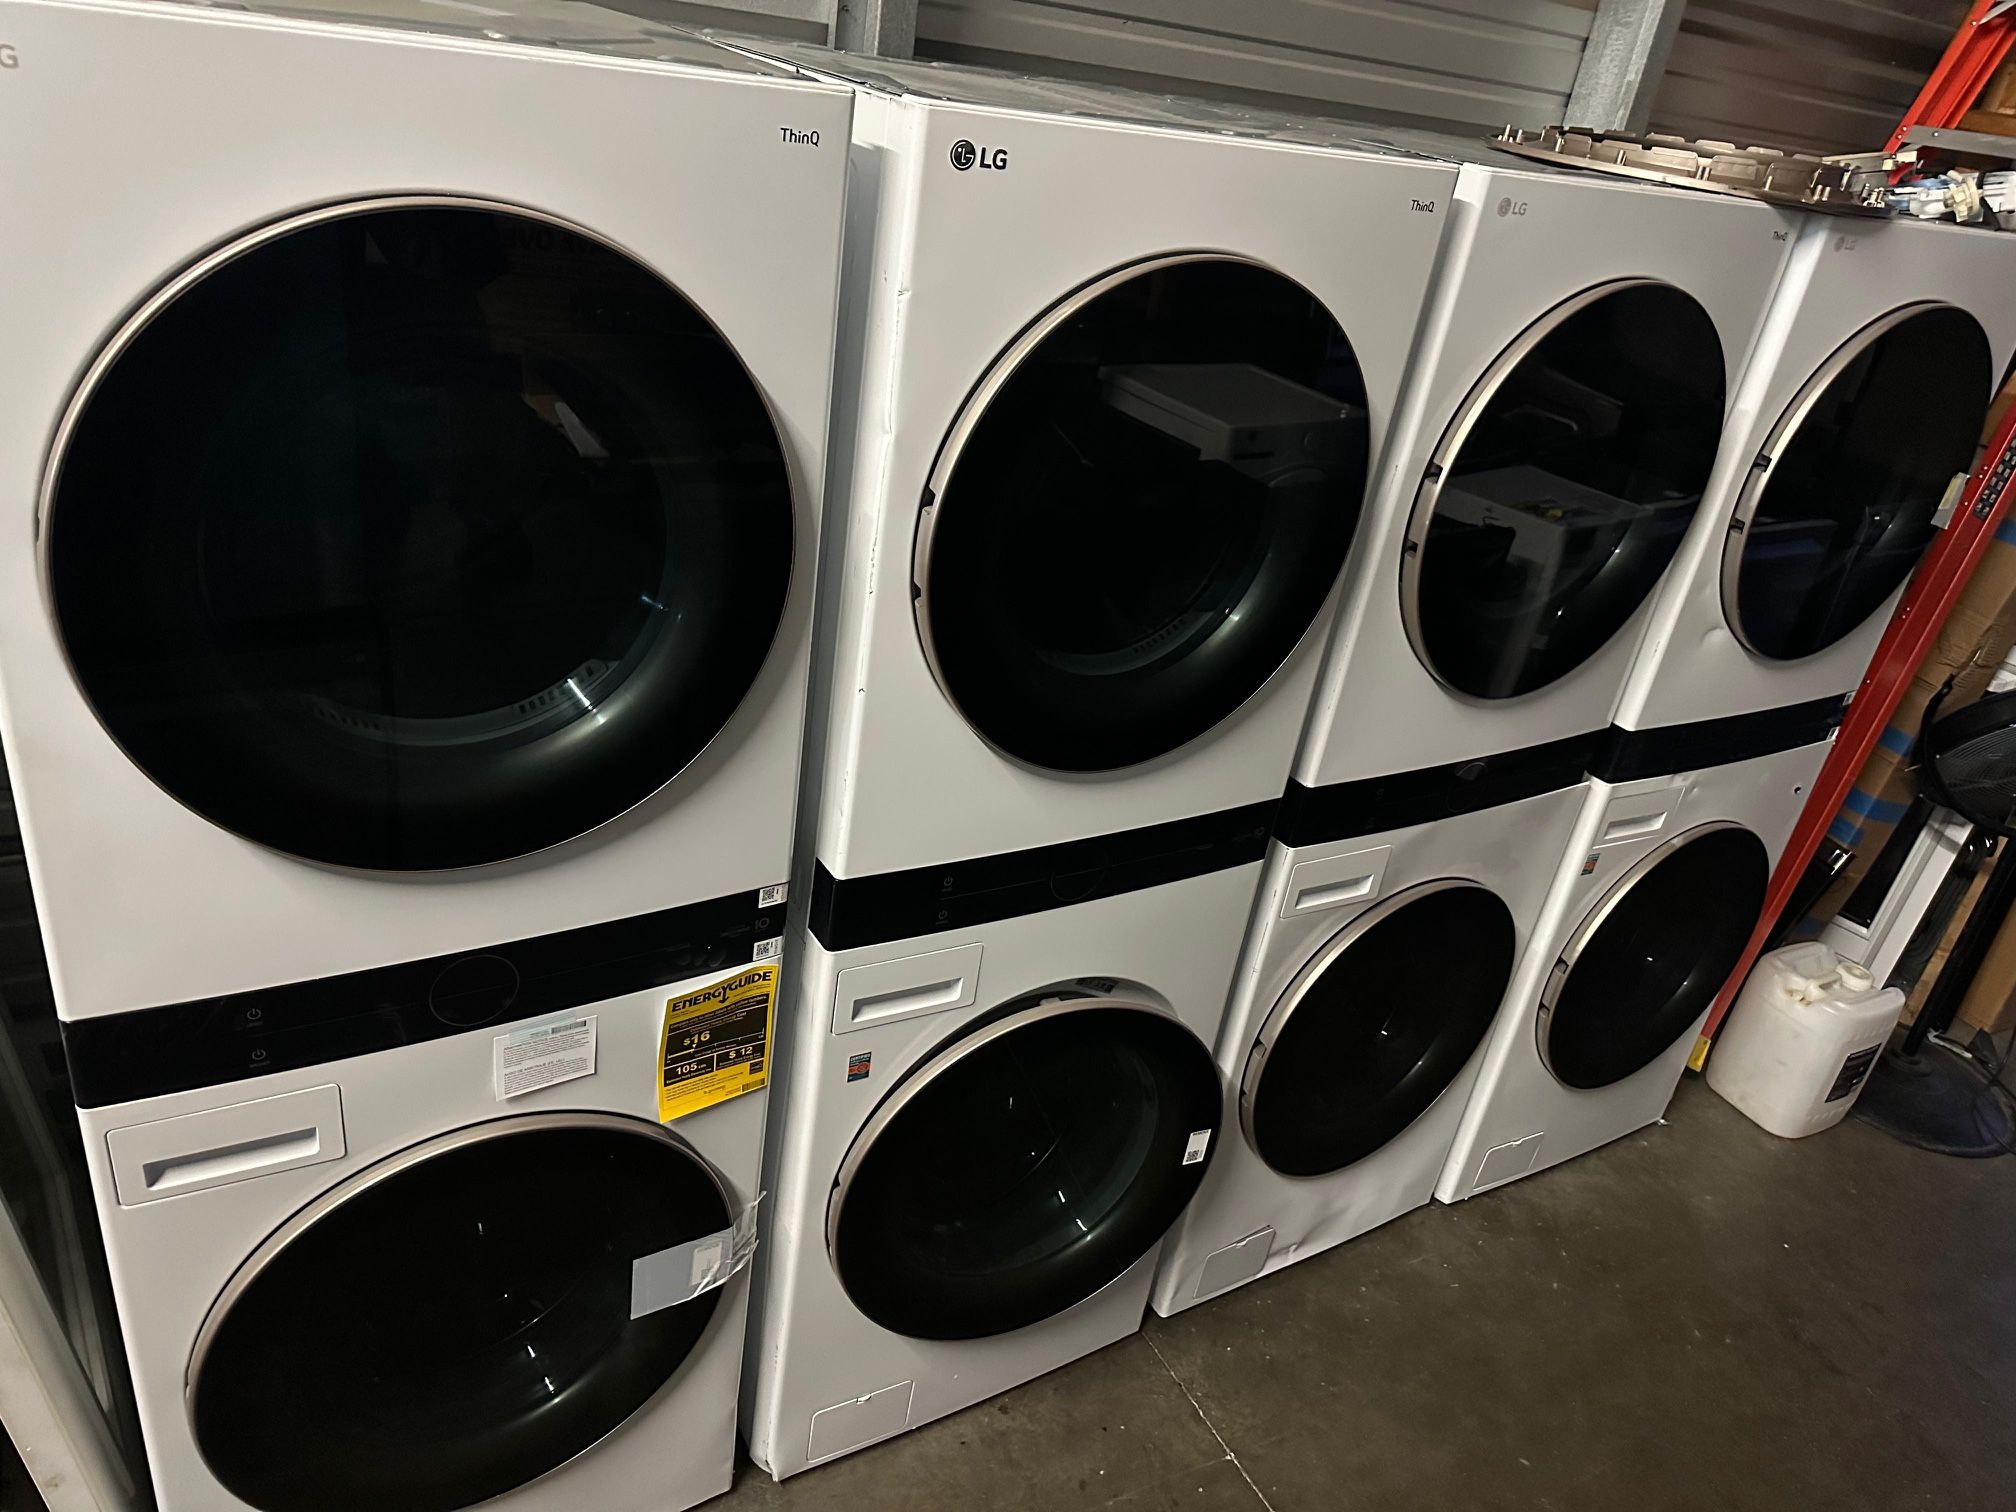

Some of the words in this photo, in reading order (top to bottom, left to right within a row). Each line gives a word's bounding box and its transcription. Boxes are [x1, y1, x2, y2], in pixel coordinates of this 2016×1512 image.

[780, 127, 820, 147] ThinQ
[979, 147, 1008, 170] LG
[1411, 199, 1435, 213] ThinQ
[1511, 202, 1528, 216] LG
[671, 971, 773, 1012] ENERGYGUIDE
[683, 1030, 711, 1046] $16
[675, 1062, 698, 1075] 105
